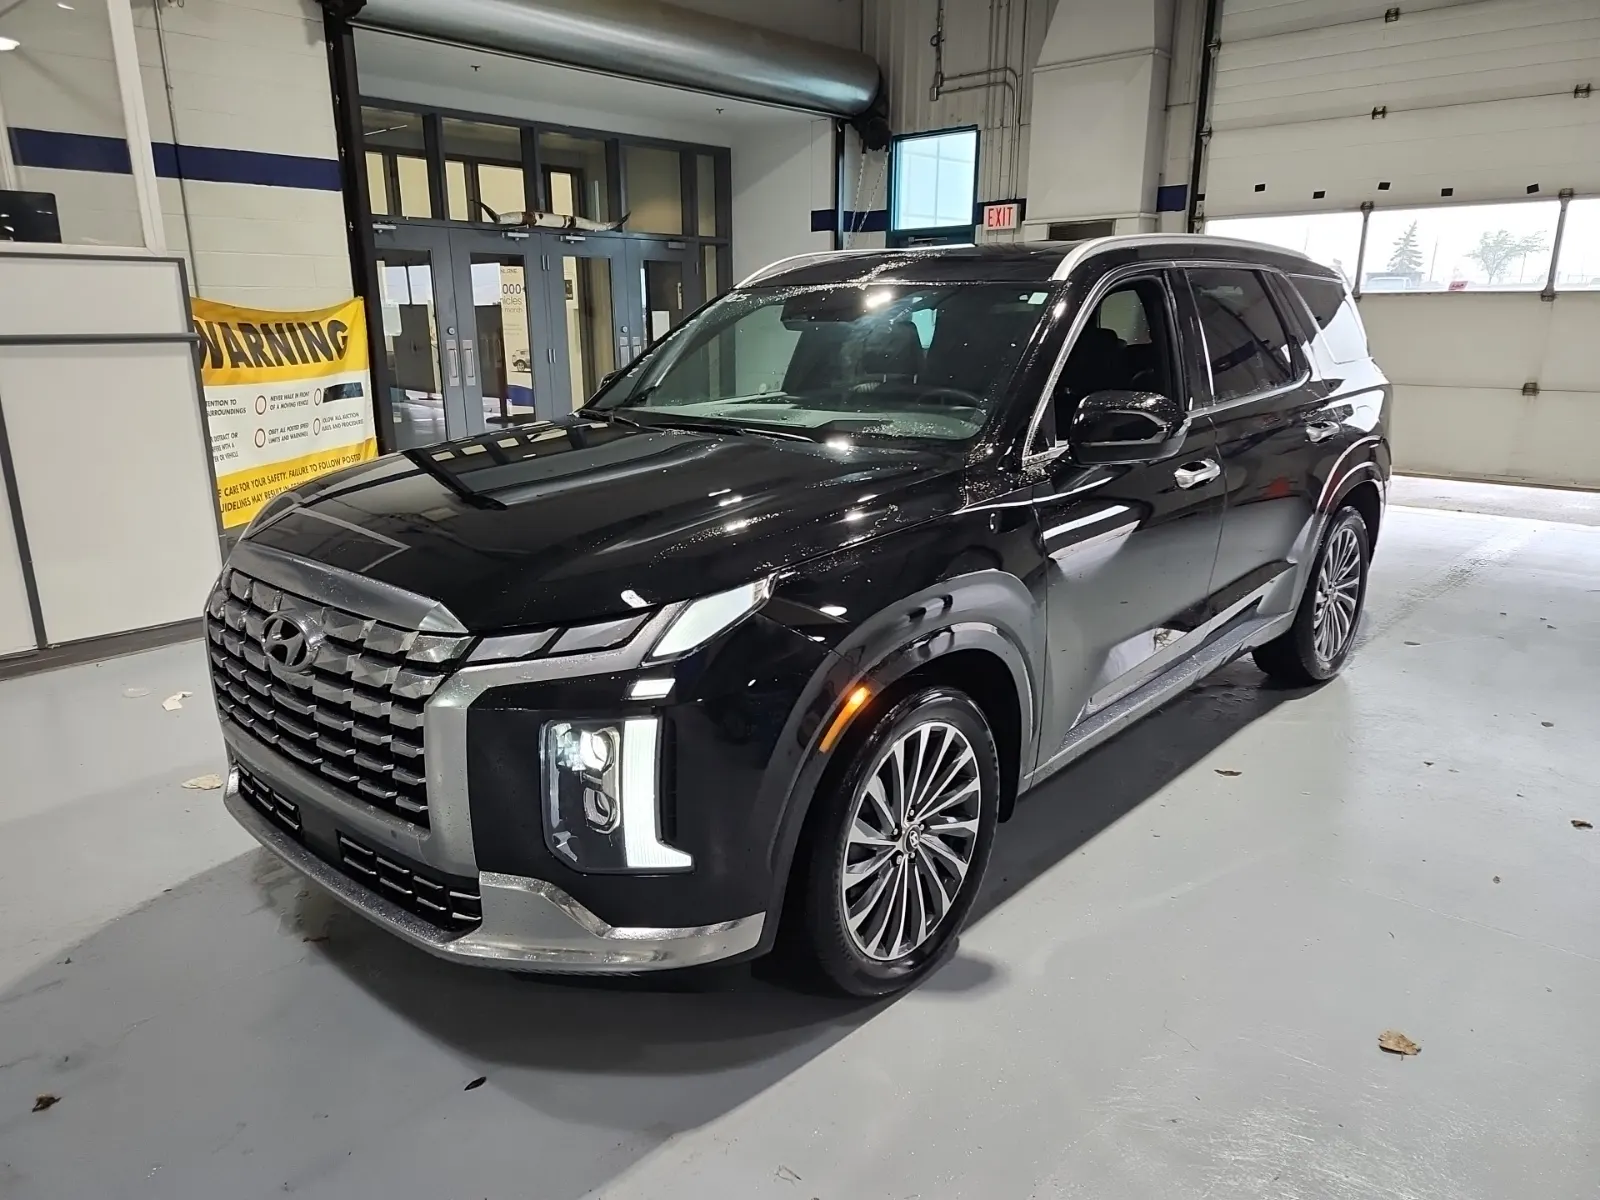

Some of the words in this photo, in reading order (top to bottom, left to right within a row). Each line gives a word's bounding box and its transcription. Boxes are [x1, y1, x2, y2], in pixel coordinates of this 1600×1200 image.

[988, 206, 1013, 227] EXIT
[193, 319, 349, 369] WARNING
[270, 394, 284, 402] NEVER
[281, 401, 296, 409] MOVING
[224, 483, 240, 496] CARE
[239, 481, 250, 493] FOR
[250, 477, 268, 488] YOUR
[289, 464, 309, 478] FAILURE
[309, 463, 318, 473] TO
[318, 457, 341, 471] FOLLOW
[342, 453, 361, 464] POSTED
[251, 493, 263, 504] MAY
